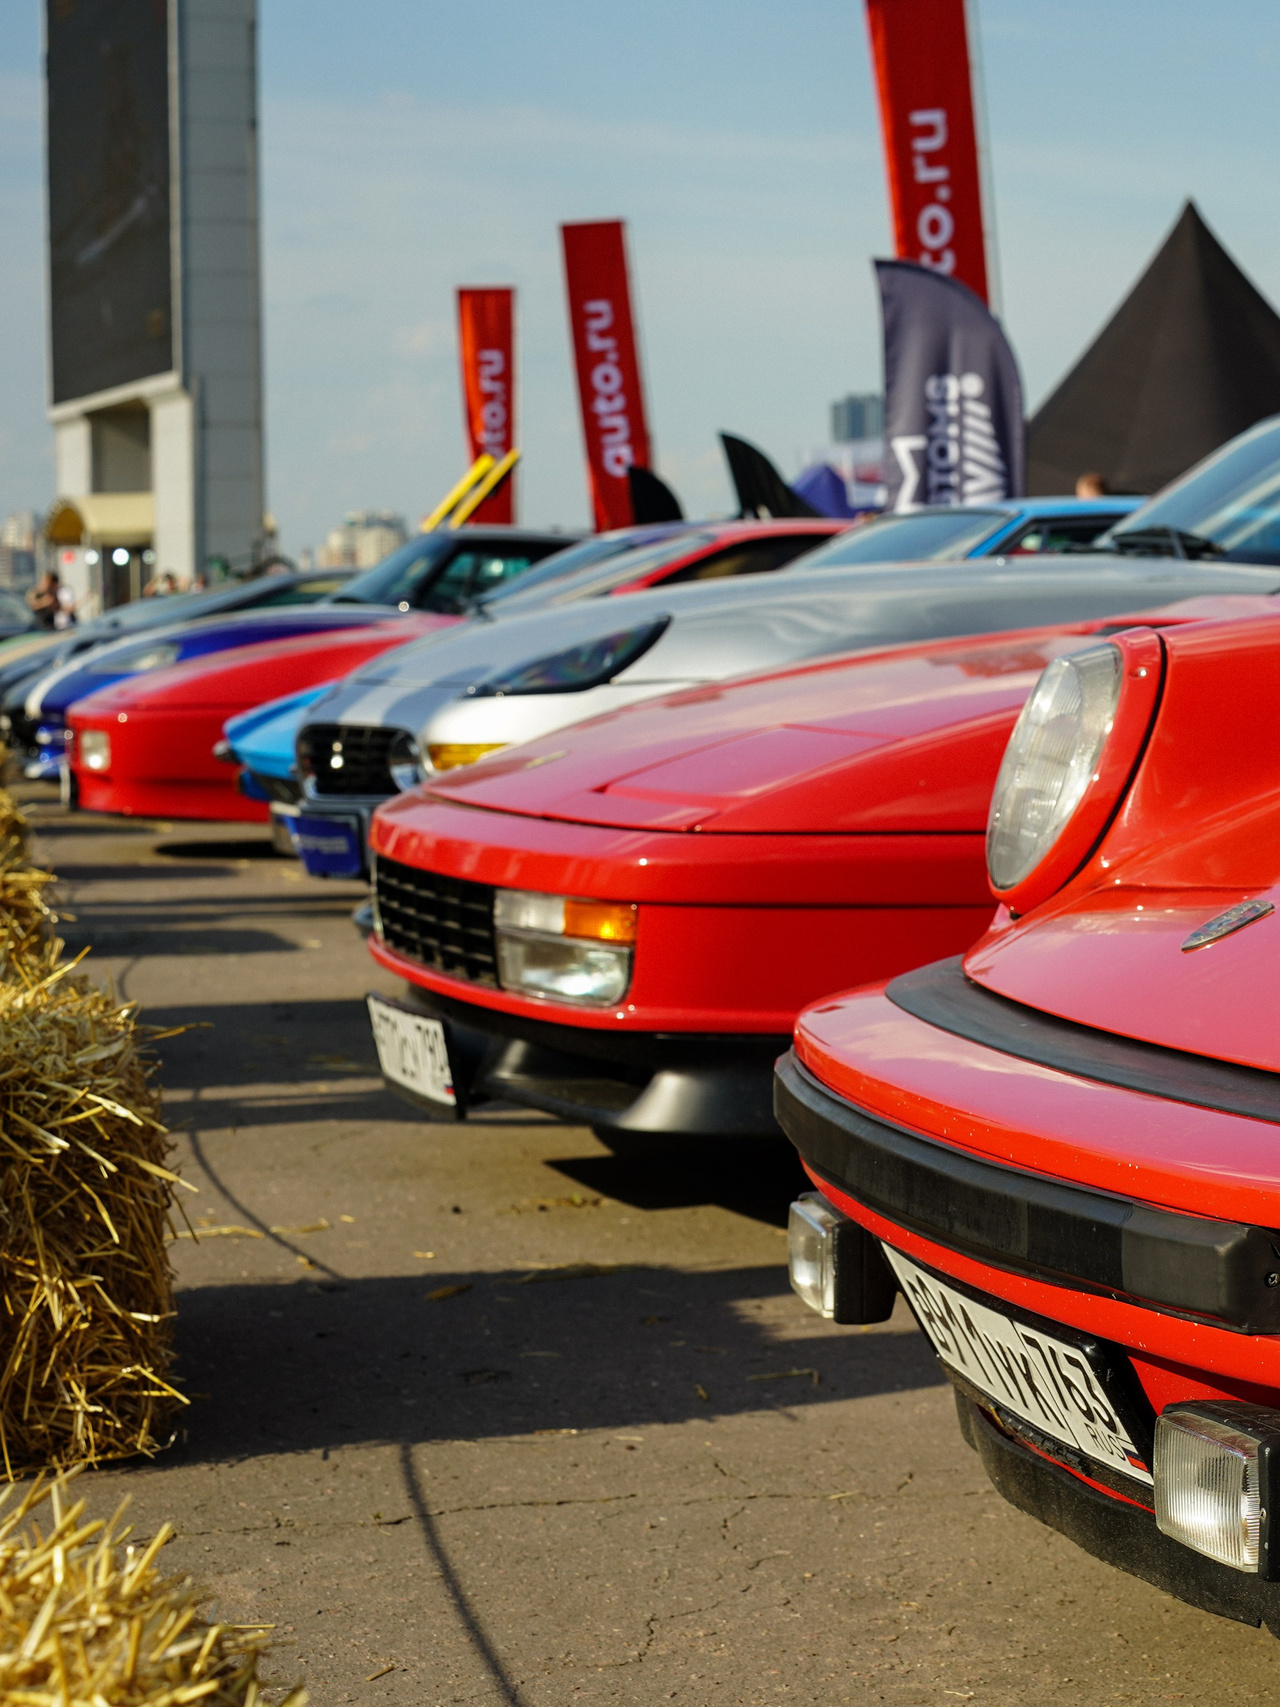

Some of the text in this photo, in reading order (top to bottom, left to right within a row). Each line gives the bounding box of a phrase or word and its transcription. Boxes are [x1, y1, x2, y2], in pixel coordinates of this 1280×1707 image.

[908, 107, 956, 278] to.ru
[583, 299, 634, 478] auto.ru
[1020, 1331, 1121, 1436] 763
[1084, 1423, 1128, 1462] RUS
